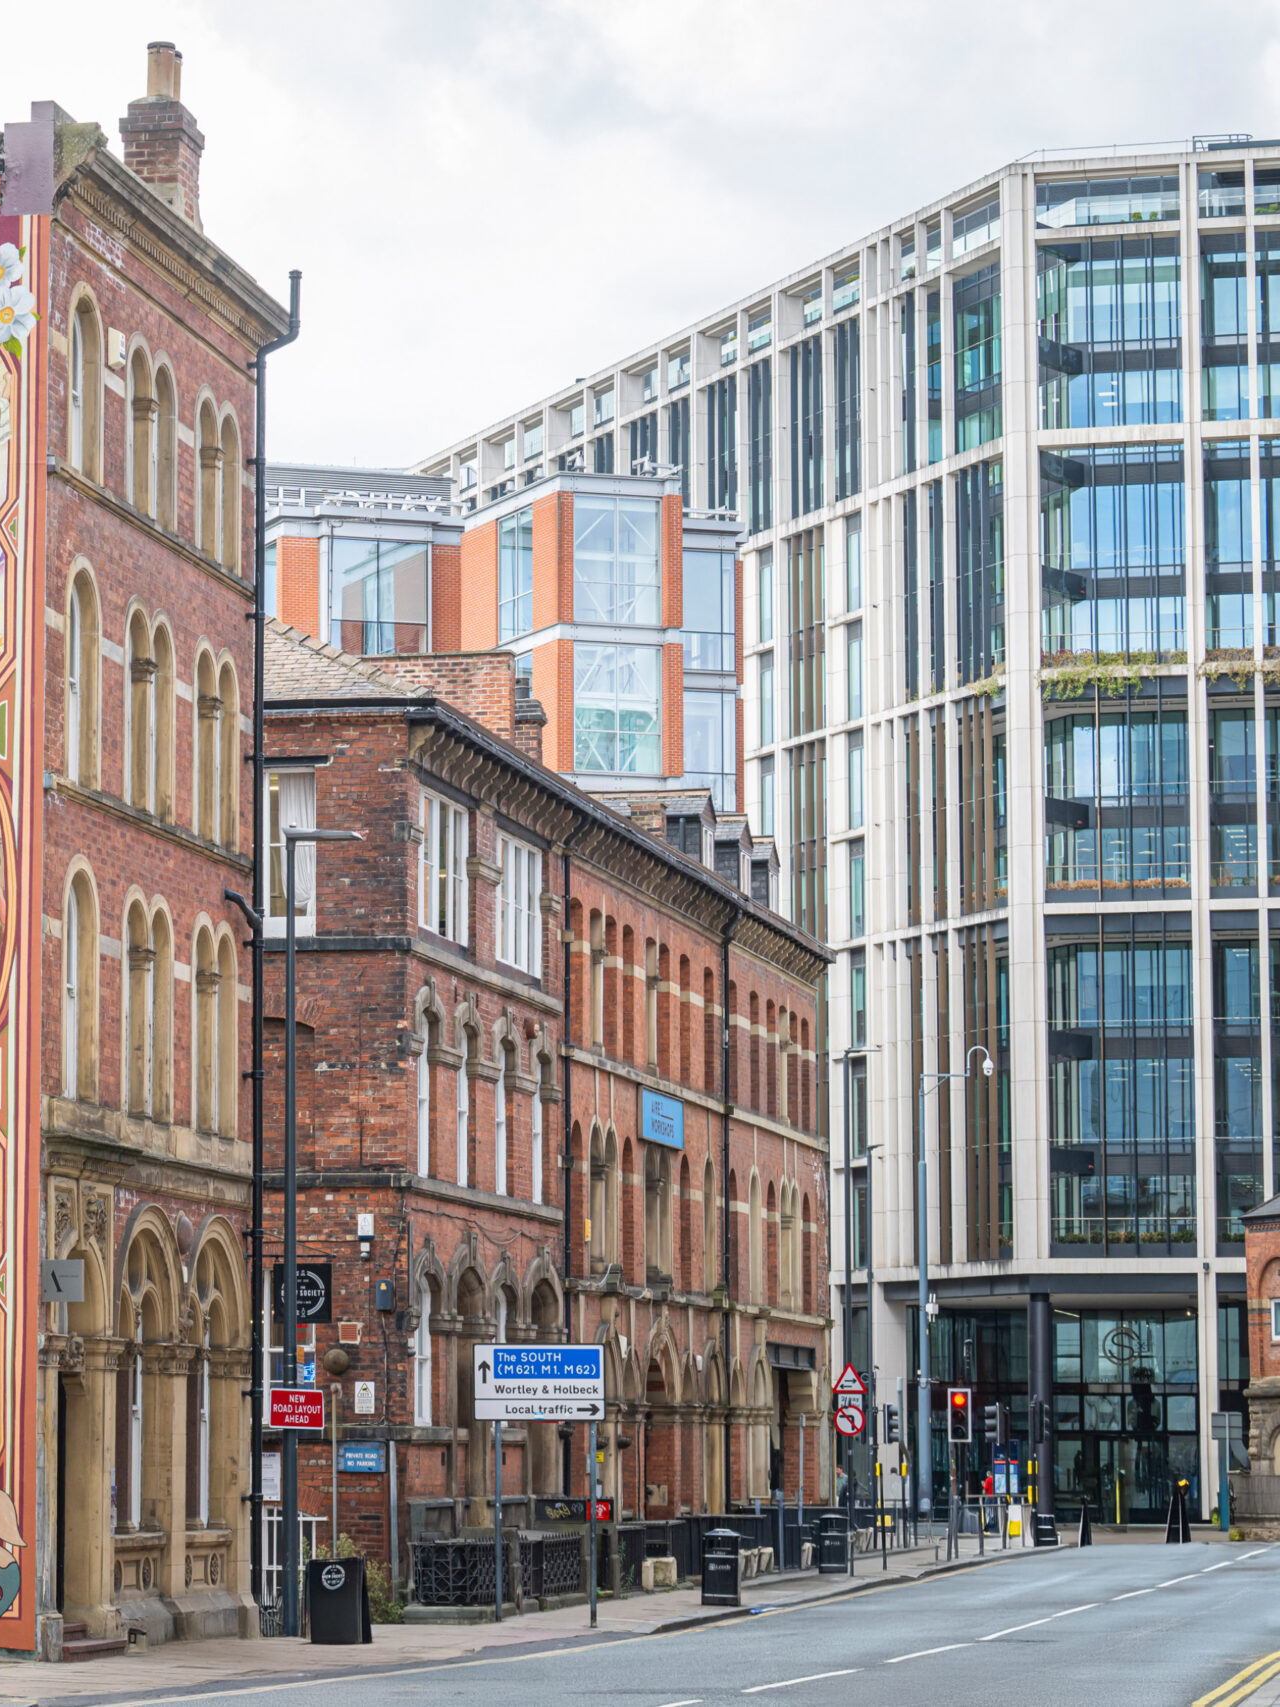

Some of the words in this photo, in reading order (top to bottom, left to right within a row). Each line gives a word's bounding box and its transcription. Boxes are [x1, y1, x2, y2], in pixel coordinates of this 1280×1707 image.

[497, 1352, 517, 1362] The
[521, 1352, 562, 1363] SOUTH
[494, 1385, 538, 1396] Wortley
[541, 1385, 550, 1394] &
[553, 1384, 599, 1394] Holbeck
[289, 1394, 306, 1404] NEW
[273, 1403, 294, 1413] ROAD
[295, 1404, 321, 1414] LAYOUT
[505, 1405, 535, 1414] Local
[538, 1405, 574, 1414] traffic
[284, 1414, 310, 1424] AHEAD
